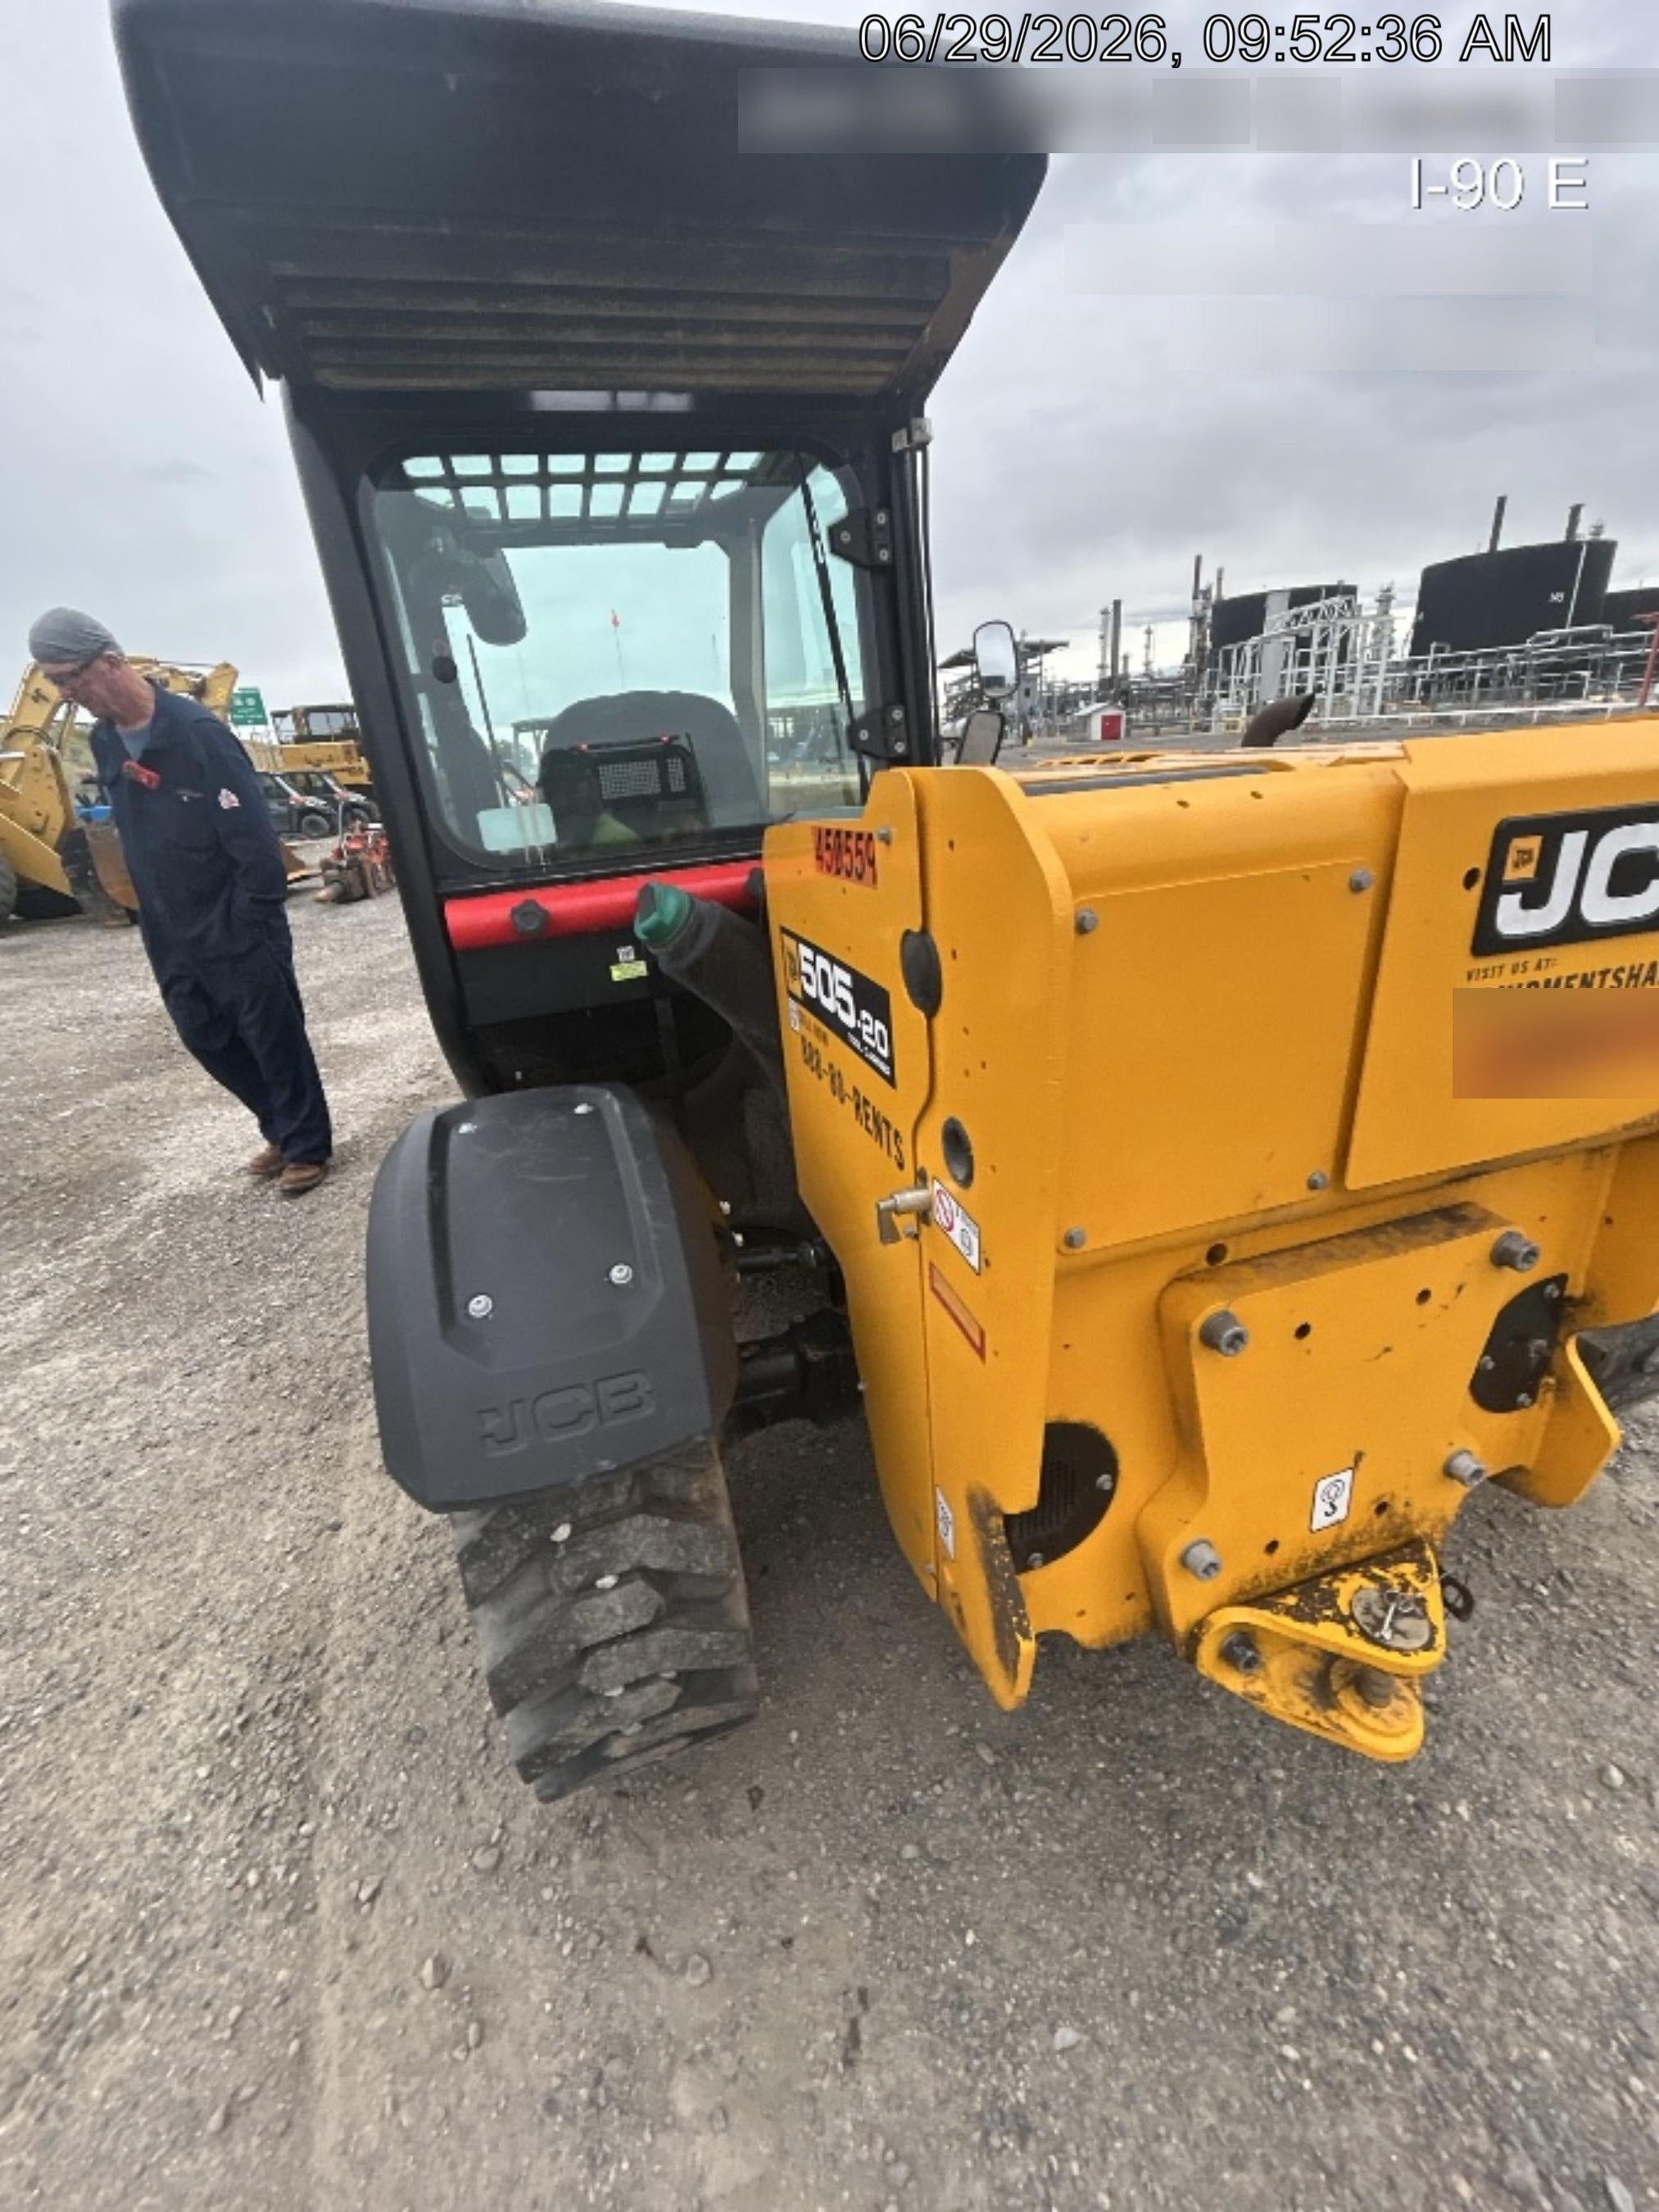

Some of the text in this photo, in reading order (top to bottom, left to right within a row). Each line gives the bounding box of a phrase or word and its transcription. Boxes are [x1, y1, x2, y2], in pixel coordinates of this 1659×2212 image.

[1466, 963, 1506, 982] VISIT
[1511, 960, 1530, 975] US
[475, 1368, 655, 1458] JCB
